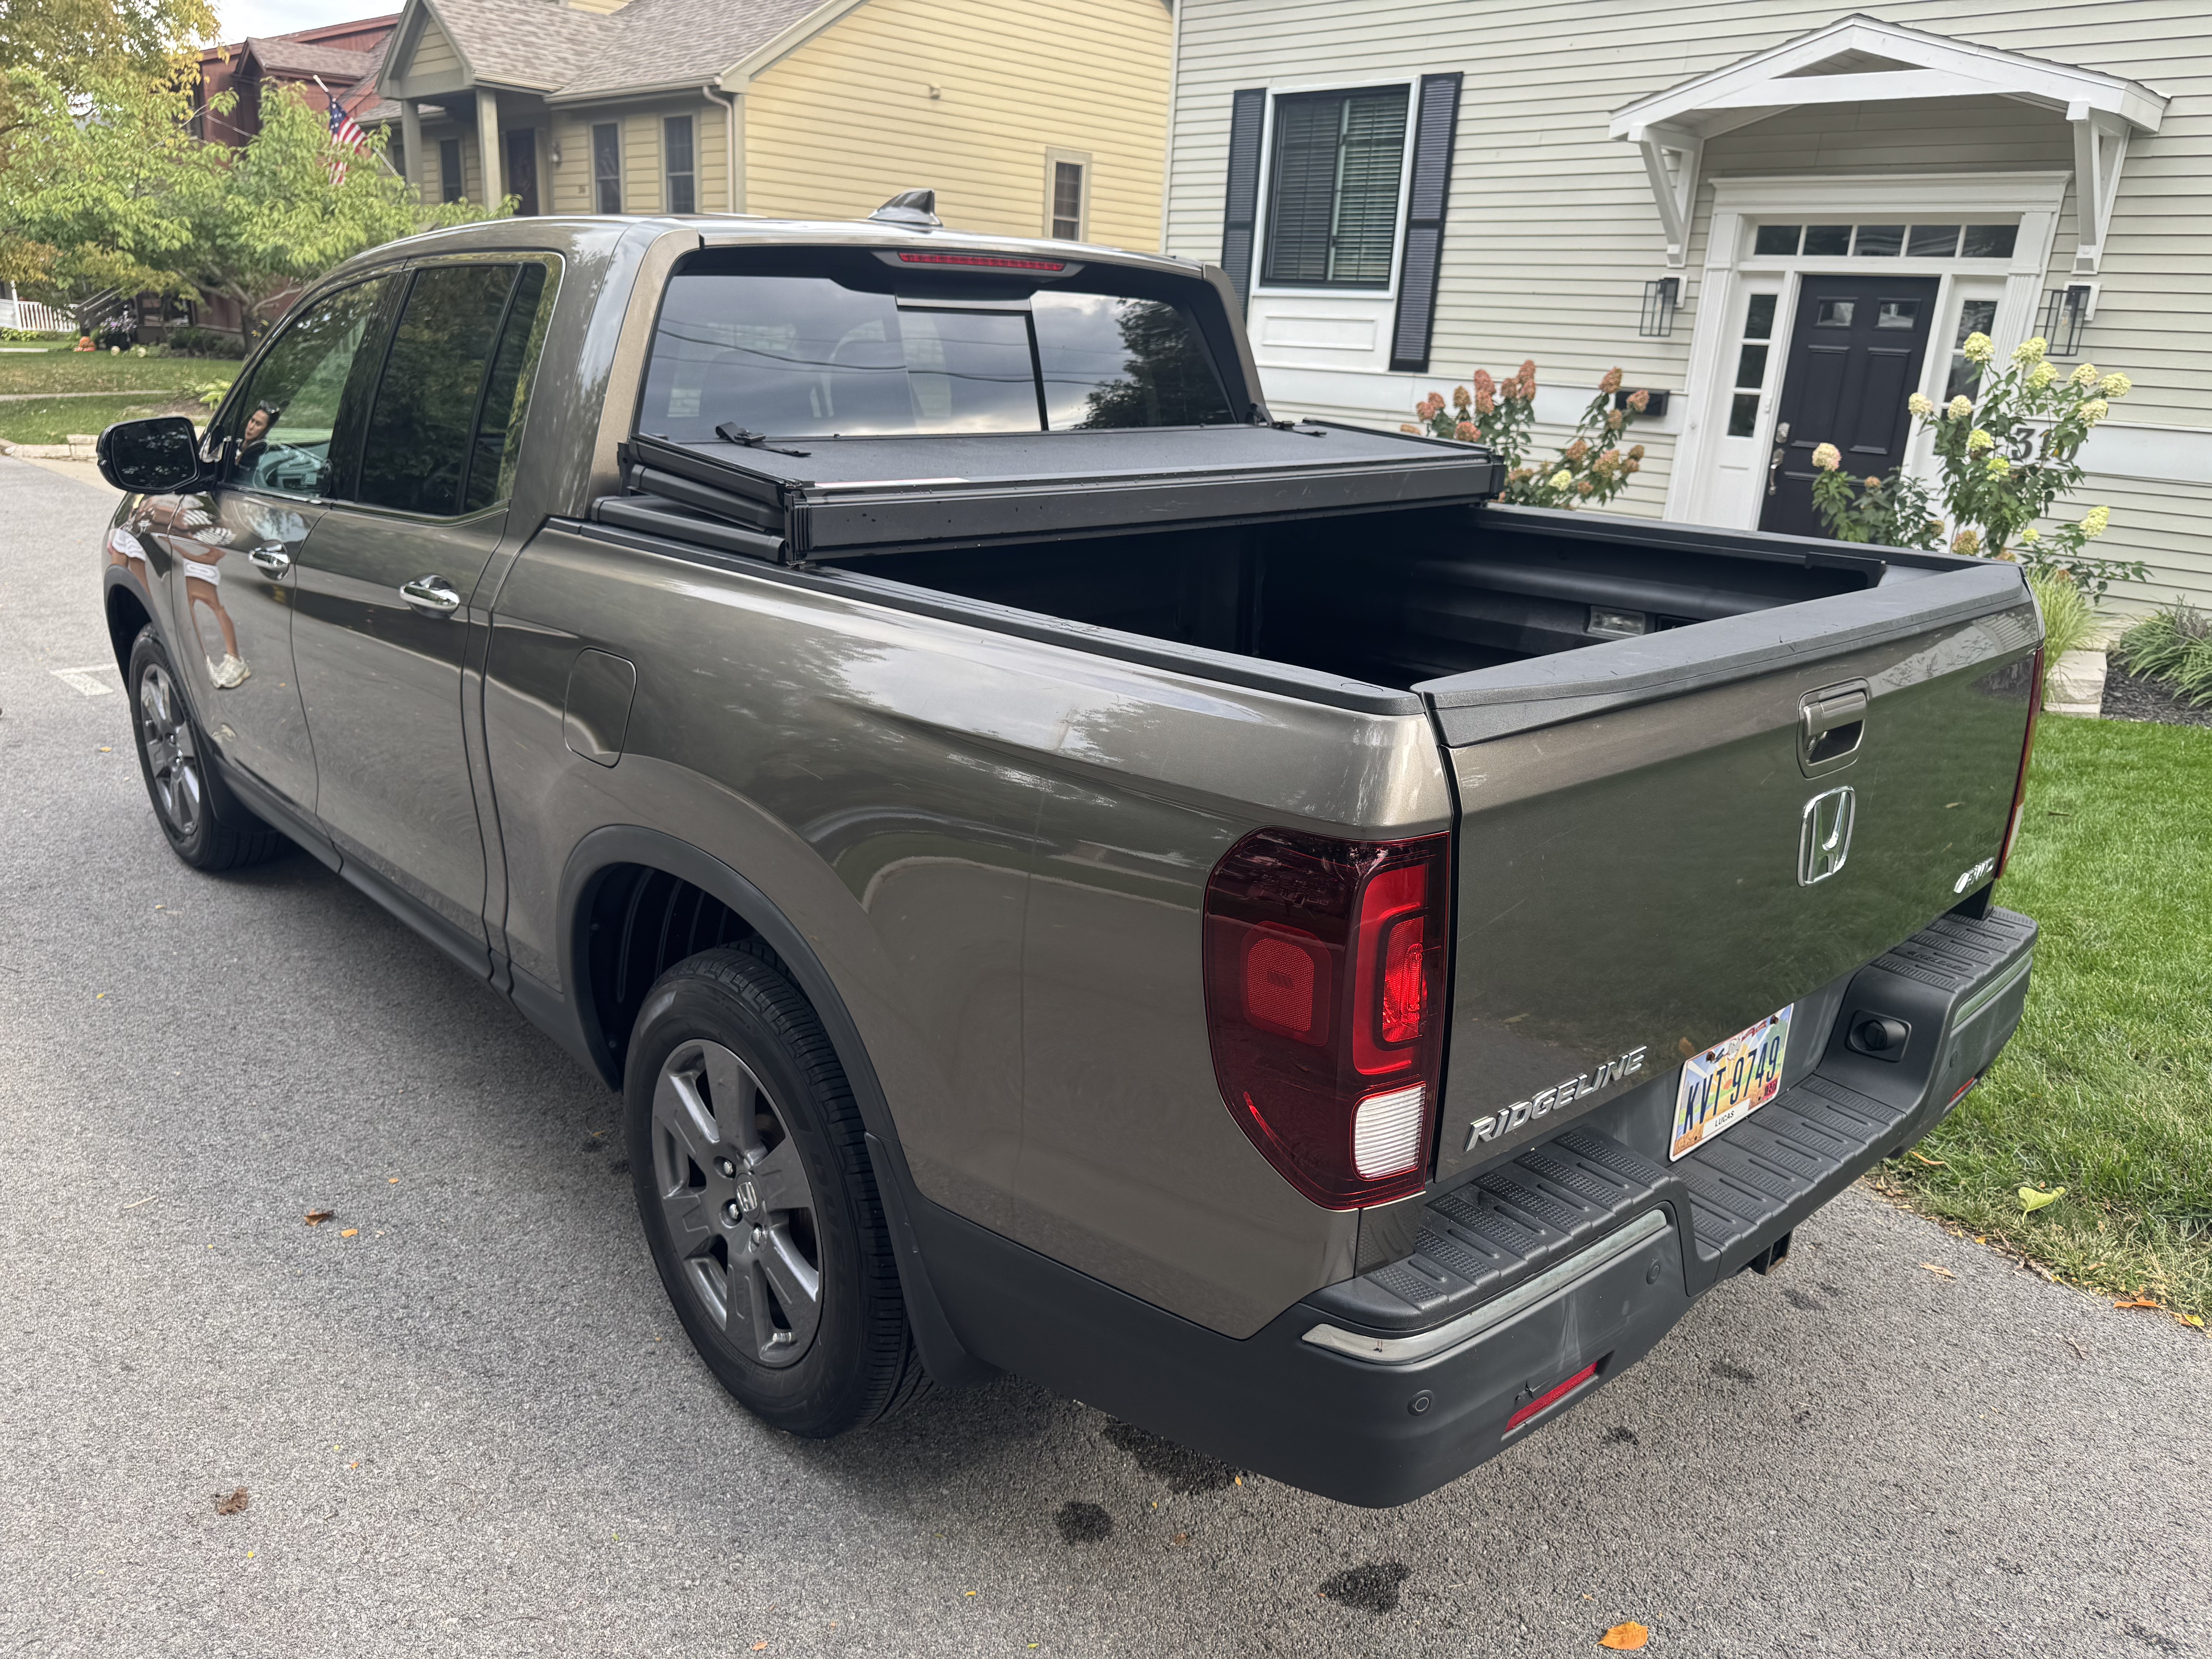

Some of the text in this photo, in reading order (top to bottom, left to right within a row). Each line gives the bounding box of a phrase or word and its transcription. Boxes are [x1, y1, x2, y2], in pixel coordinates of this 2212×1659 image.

[1463, 1045, 1647, 1152] RIDGELINE
[1683, 1036, 1780, 1134] KVT 9749
[1714, 1110, 1735, 1127] LUCAS
